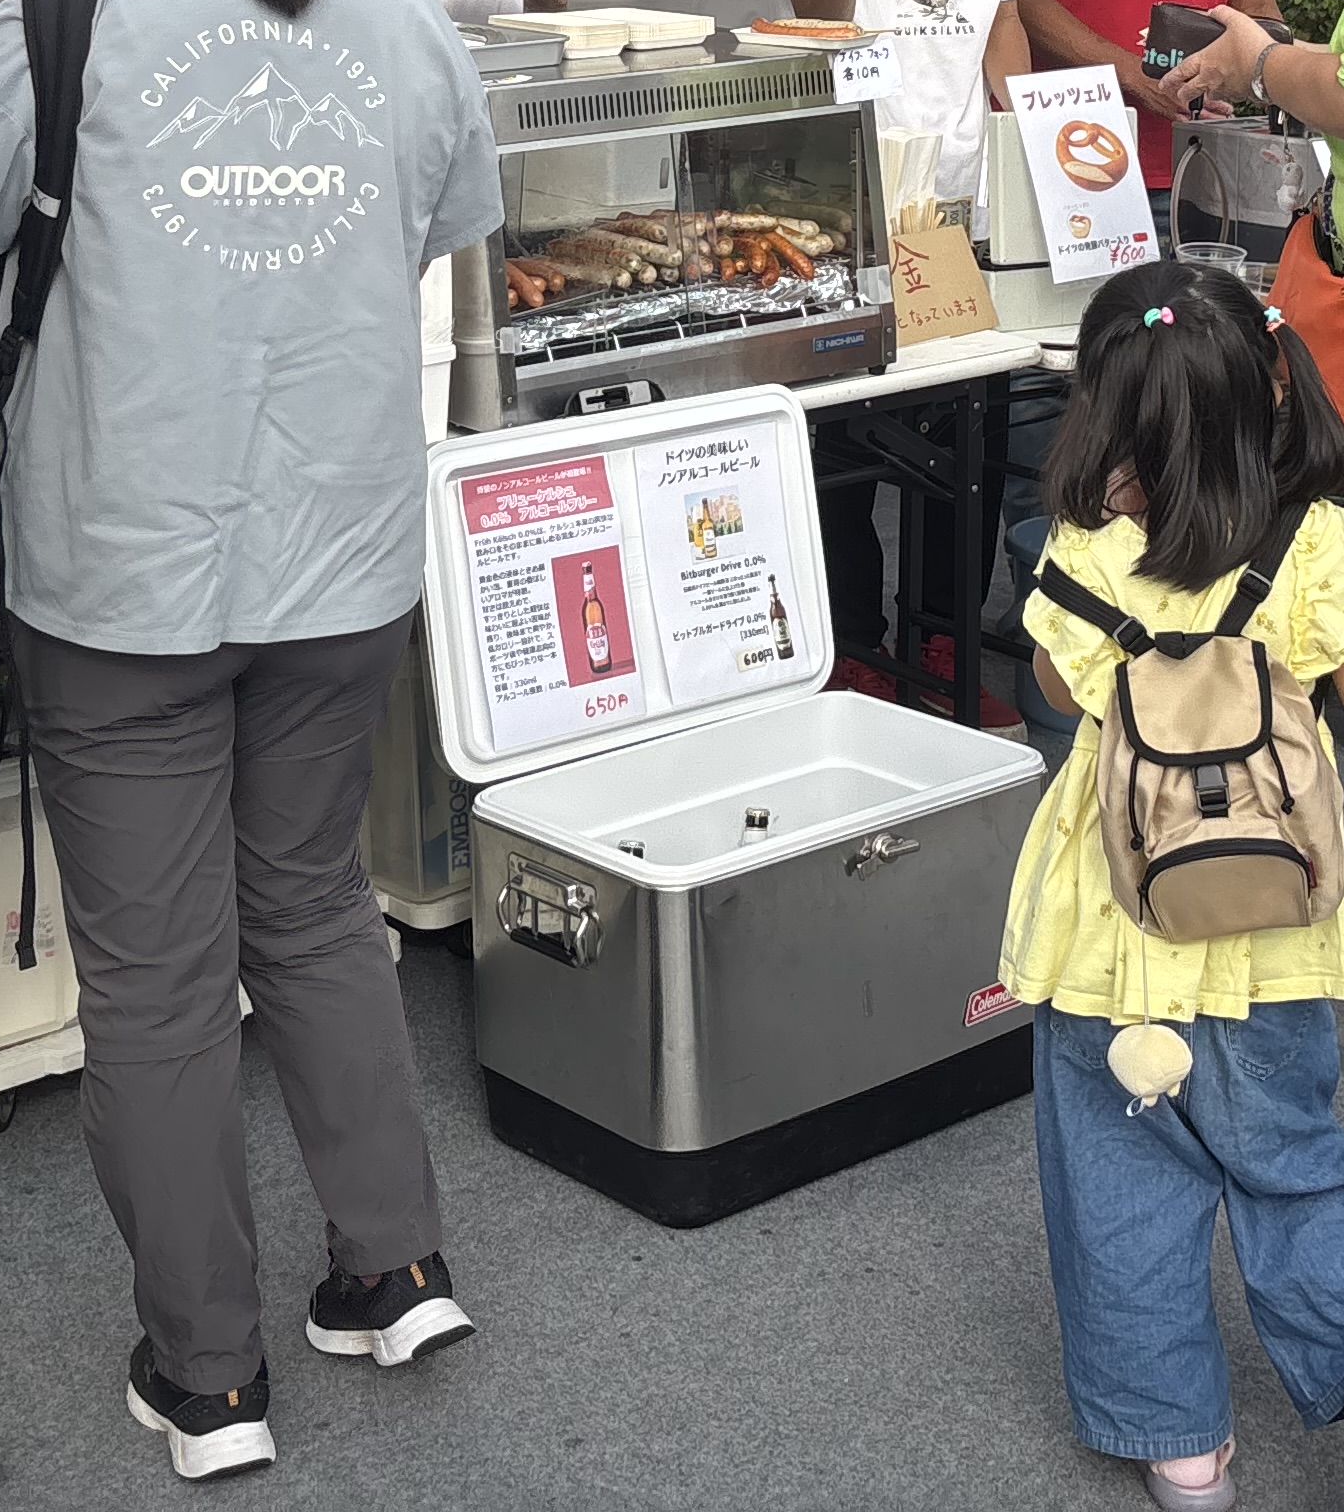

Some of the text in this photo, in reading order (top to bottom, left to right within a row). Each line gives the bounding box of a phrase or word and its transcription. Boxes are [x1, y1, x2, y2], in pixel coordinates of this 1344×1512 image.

[893, 24, 976, 36] QUIKSILVER
[140, 20, 386, 109] CALIFORNIA 1973
[1021, 83, 1111, 111] プレッツェル
[180, 164, 346, 198] OUTDOOR
[1109, 244, 1146, 268] ¥600
[665, 438, 749, 465] ドイツの美味しい
[658, 456, 760, 487] ノンアルコールビール
[681, 565, 719, 581] Bitburger
[743, 648, 774, 666] 600円
[585, 693, 628, 718] 650円
[971, 990, 1012, 1016] Colema
